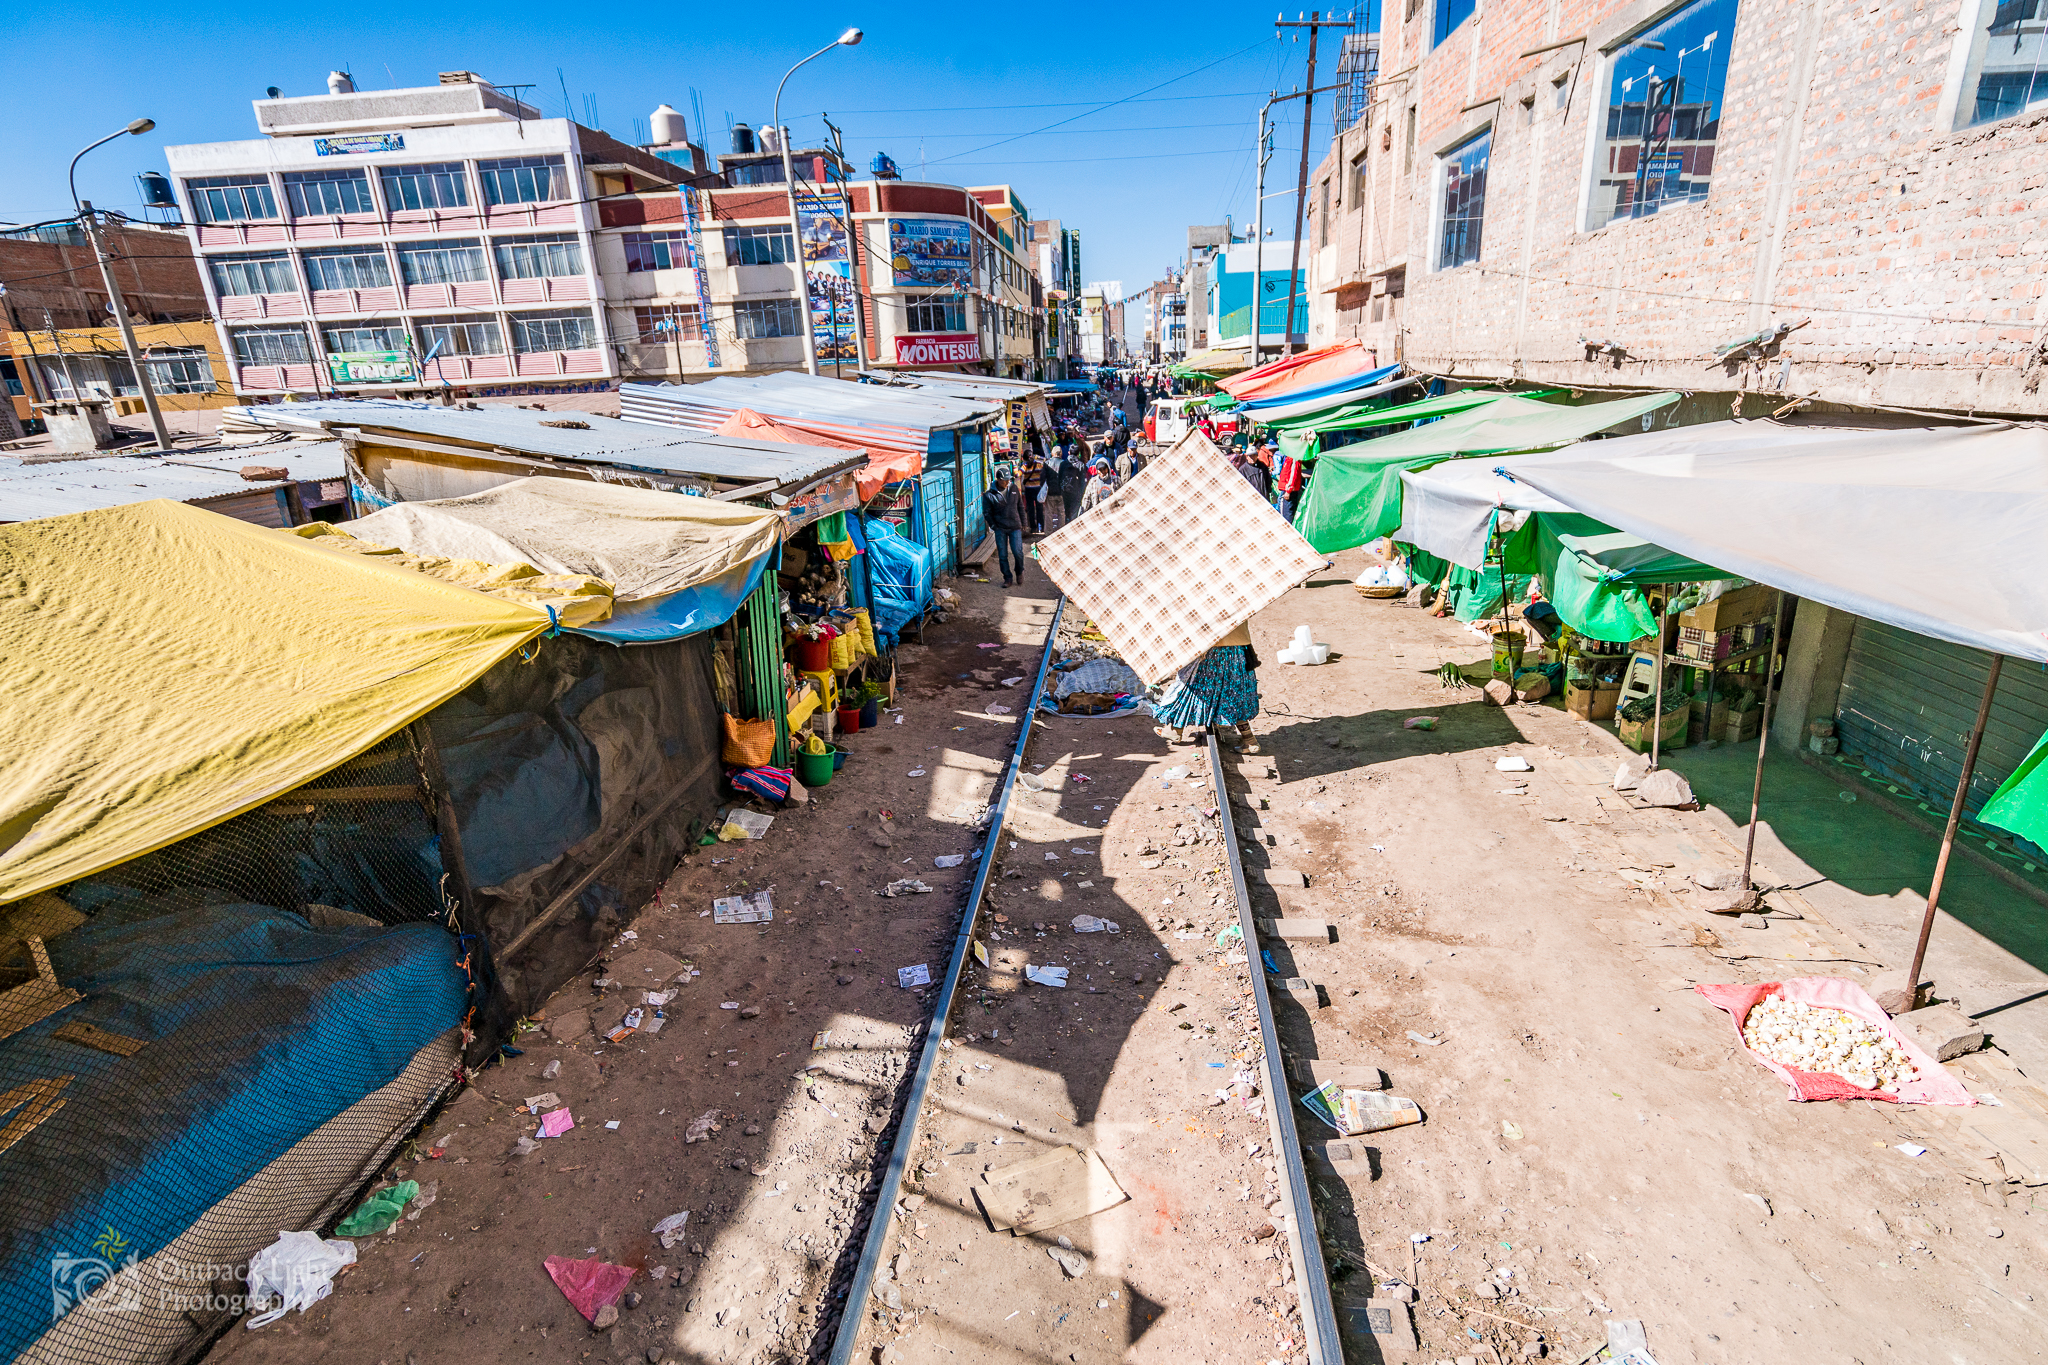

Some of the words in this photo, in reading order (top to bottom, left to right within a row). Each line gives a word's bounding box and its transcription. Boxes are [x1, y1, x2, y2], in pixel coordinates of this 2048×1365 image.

[819, 202, 843, 211] SAMAM
[908, 224, 929, 235] MARIO
[930, 226, 952, 237] SAMAME
[1072, 235, 1080, 265] HOTEL
[691, 216, 710, 296] TORRES
[705, 303, 722, 366] BELON
[899, 343, 981, 362] MONTESUR
